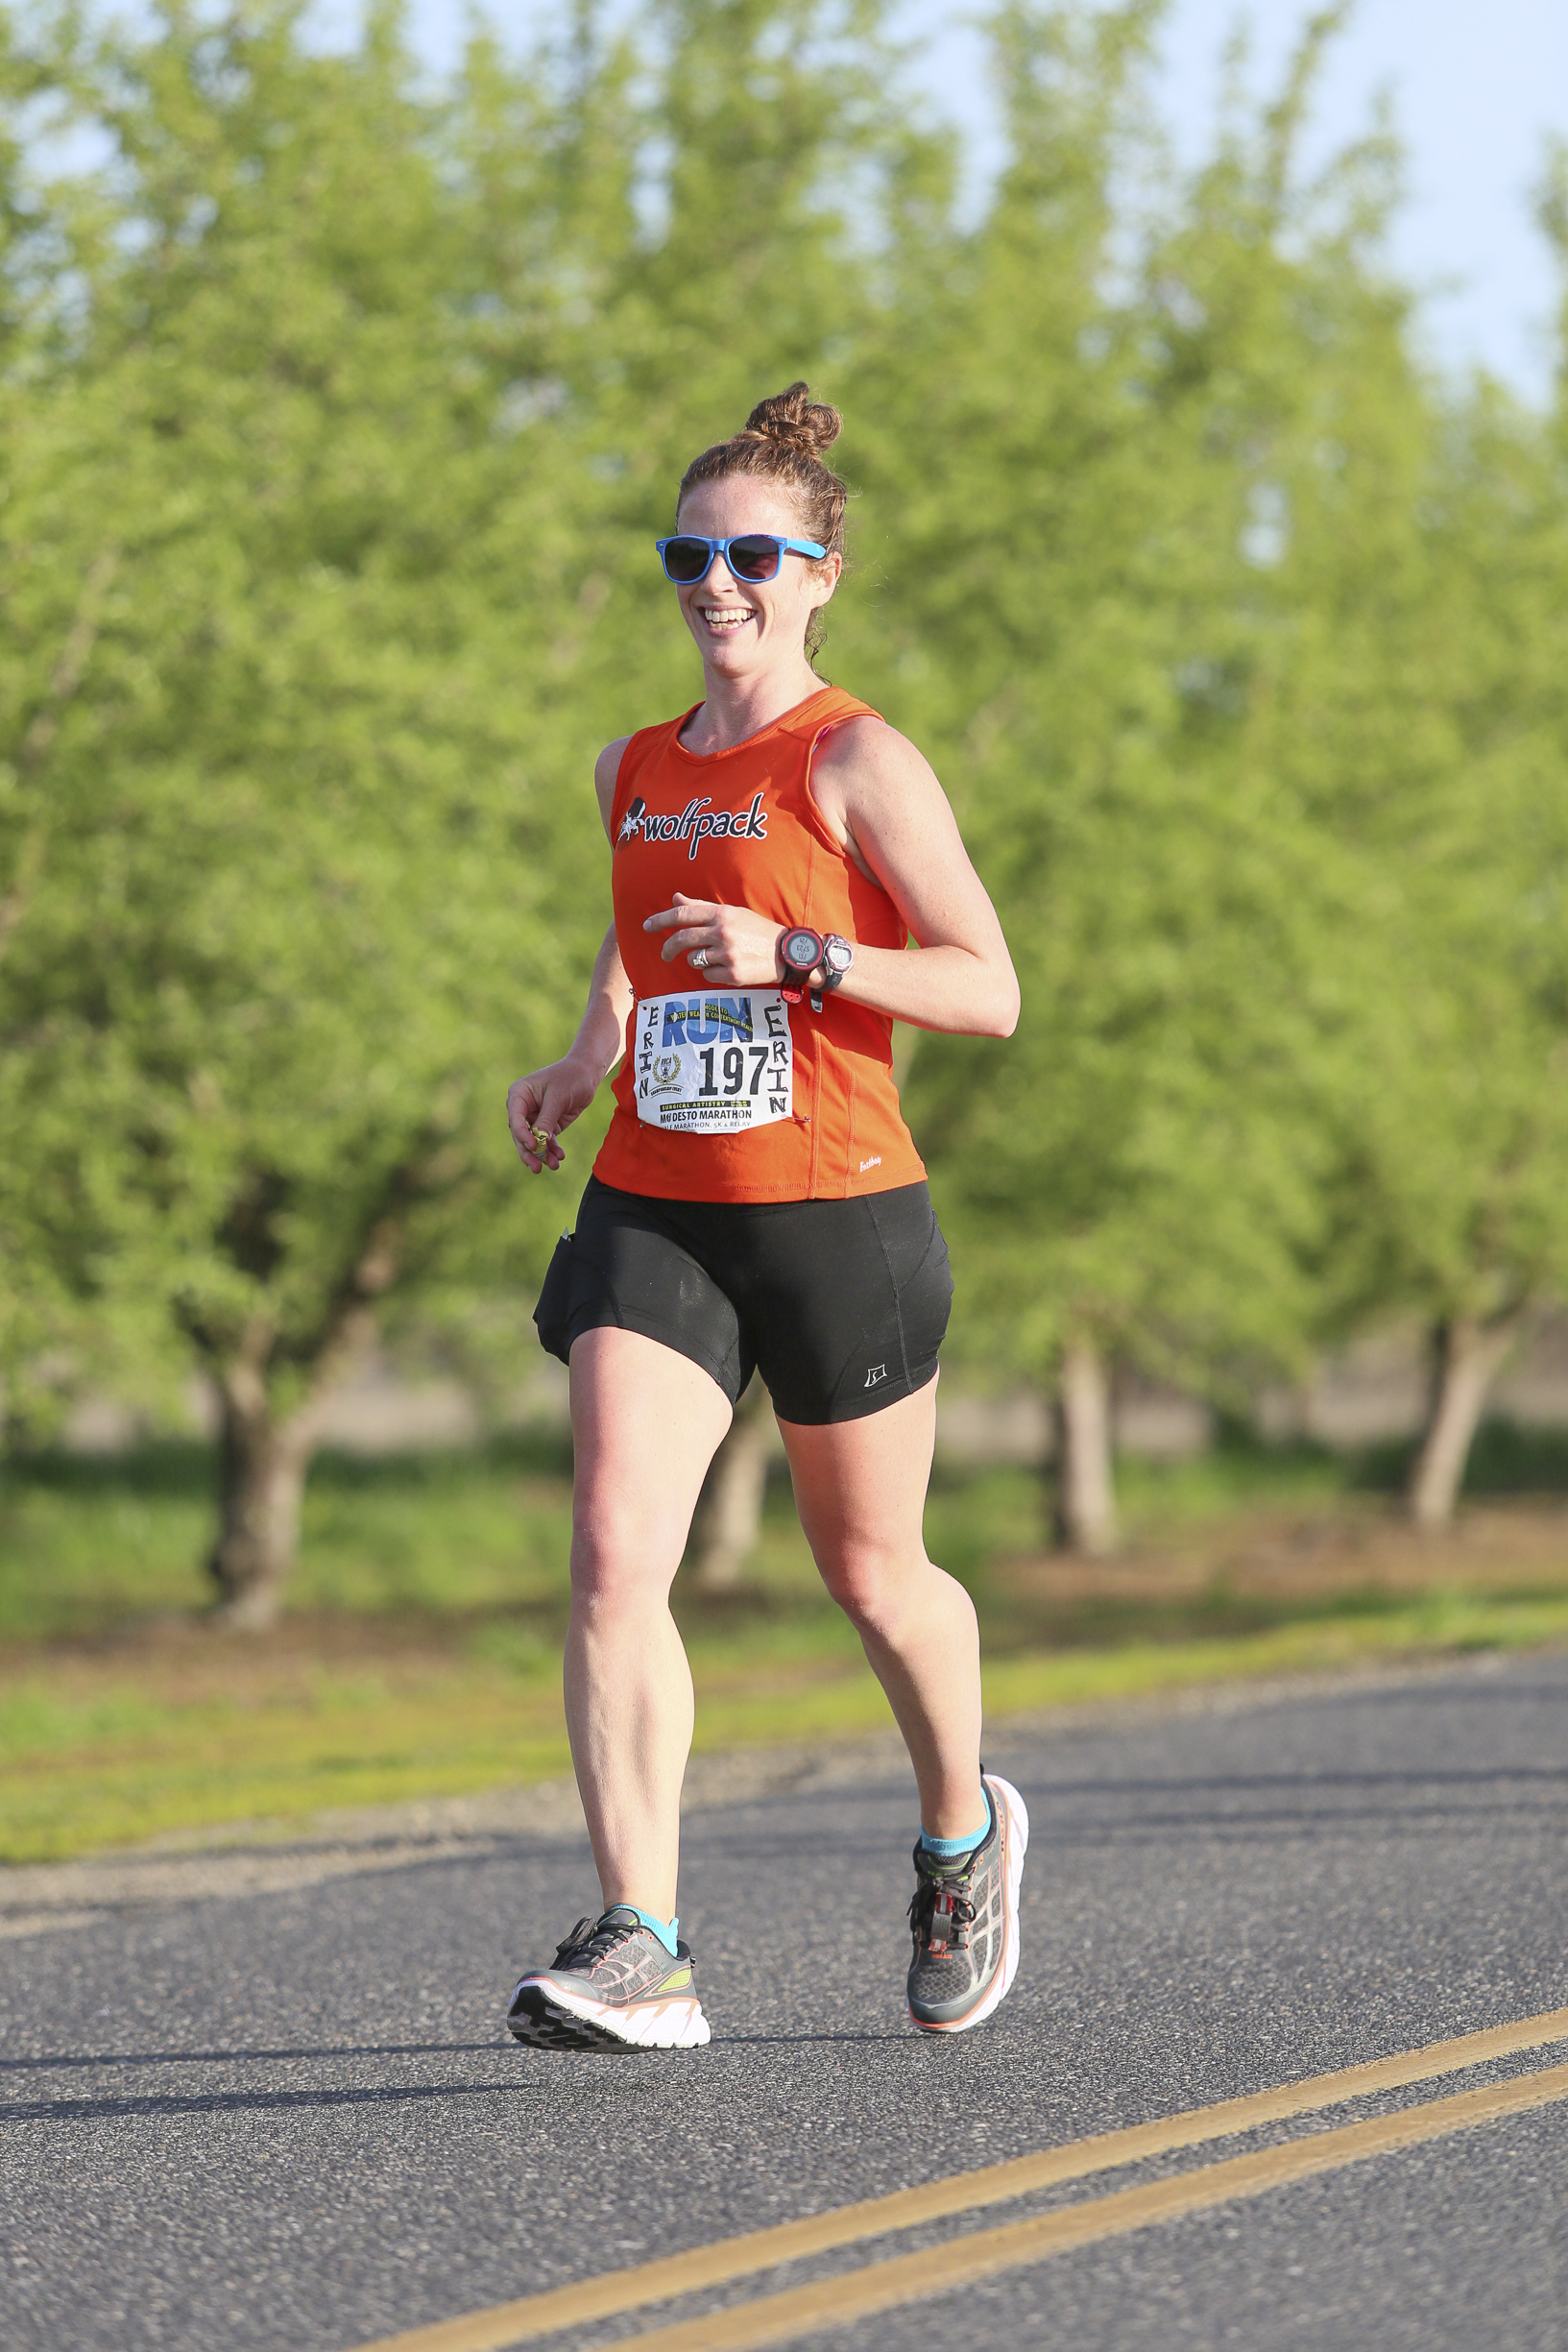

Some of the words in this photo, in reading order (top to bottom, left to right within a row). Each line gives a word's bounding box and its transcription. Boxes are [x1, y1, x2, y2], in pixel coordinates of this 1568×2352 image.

[644, 791, 768, 861] wolfpack
[662, 997, 754, 1047] RUN
[639, 1006, 660, 1100] ERIN
[699, 1047, 769, 1096] 197
[763, 1005, 789, 1114] ERIN
[662, 1103, 690, 1111] SURGICAL
[699, 1109, 752, 1120] MARATHON
